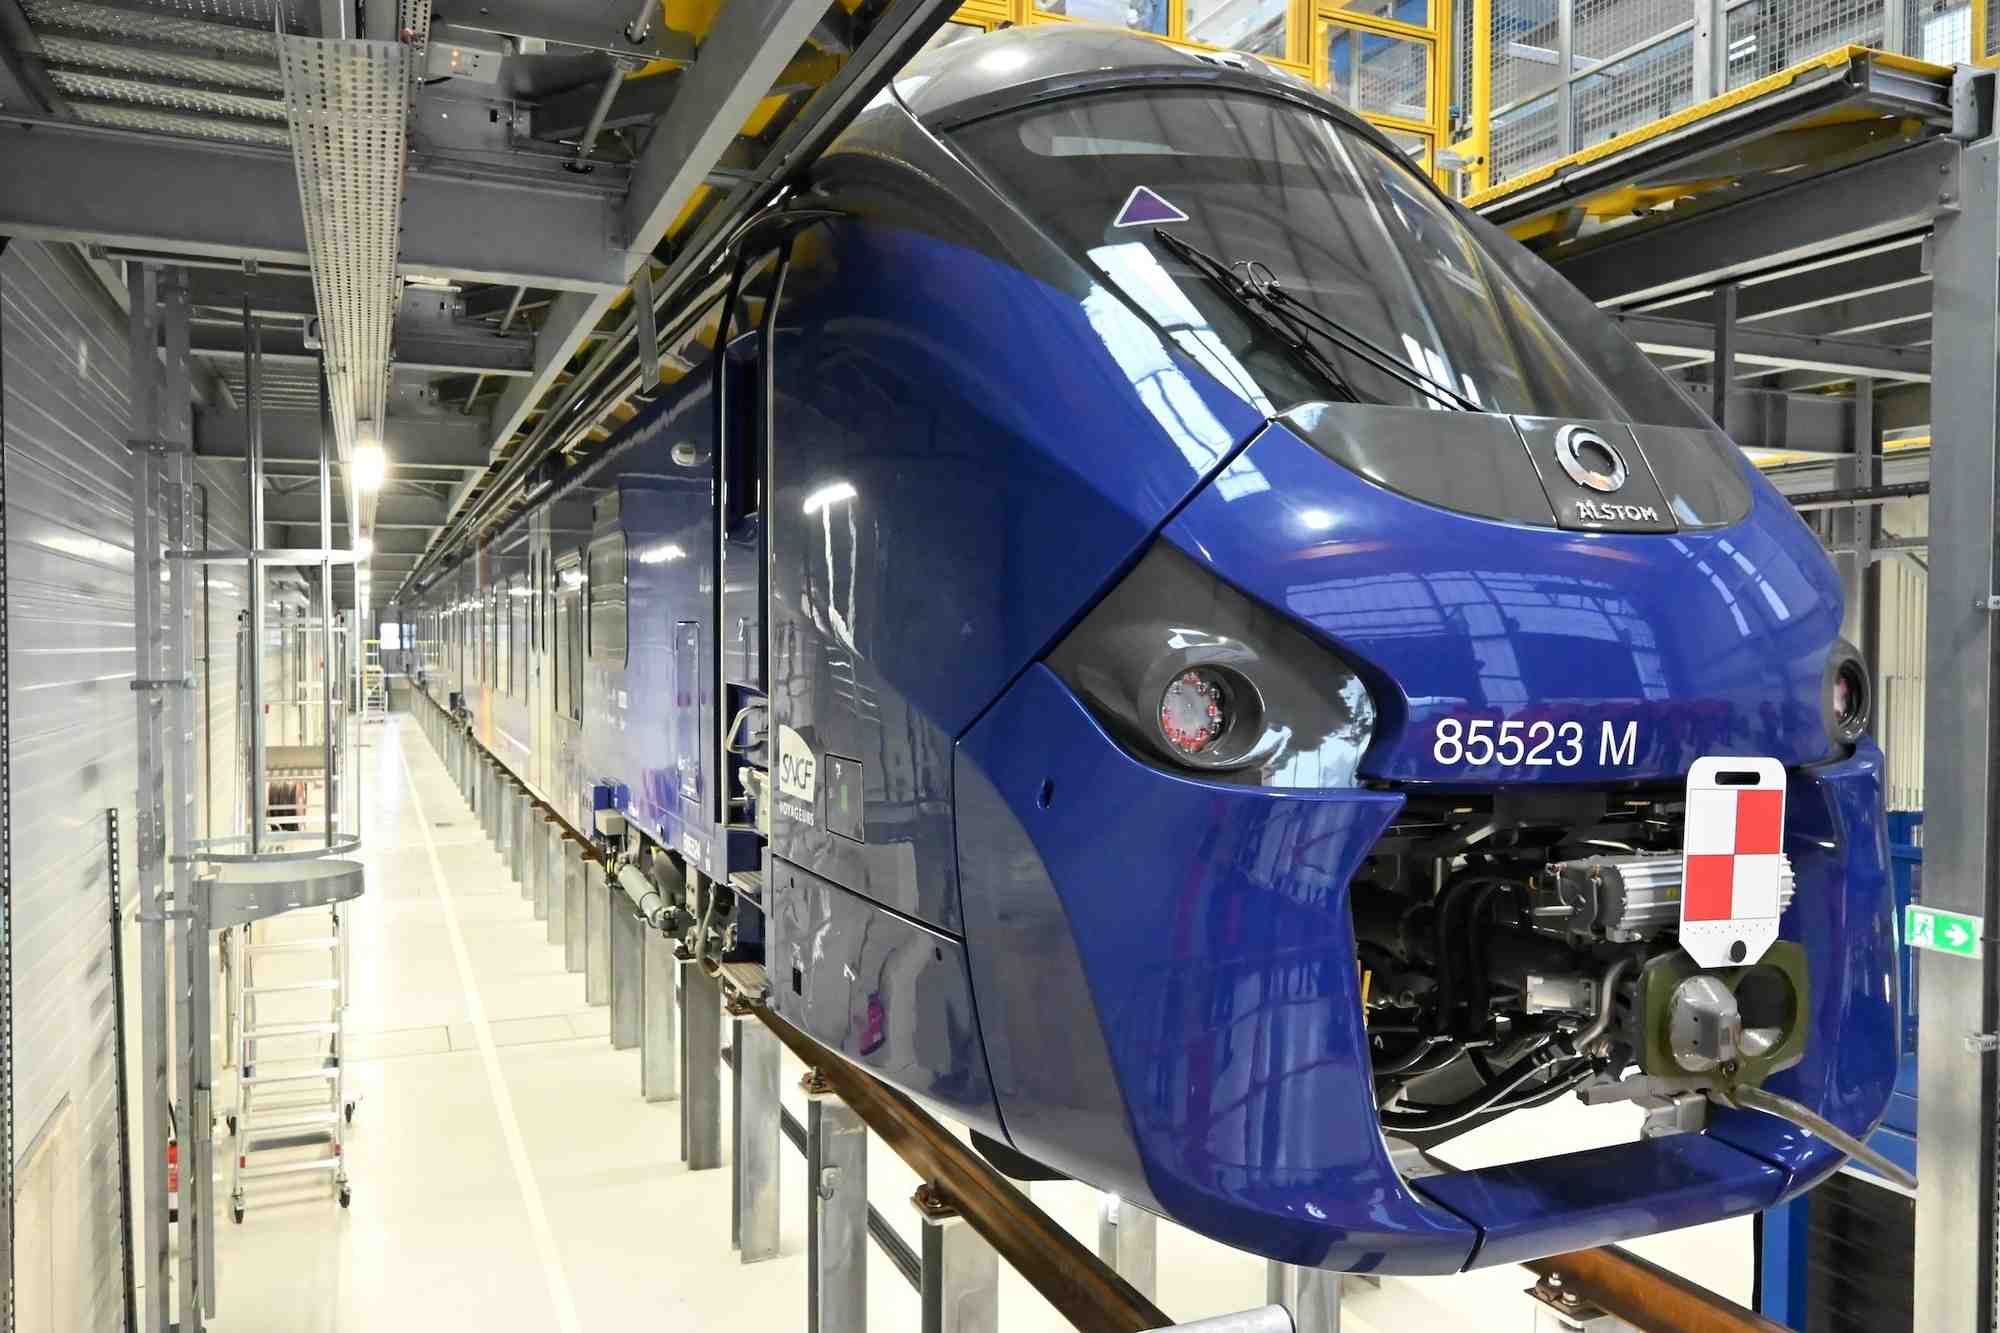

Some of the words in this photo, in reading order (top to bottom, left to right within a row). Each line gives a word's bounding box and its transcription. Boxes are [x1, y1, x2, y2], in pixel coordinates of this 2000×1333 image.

[1576, 499, 1659, 521] ALSTOM
[1433, 718, 1583, 767] 85523
[1599, 720, 1638, 766] M
[781, 753, 814, 789] SNCF
